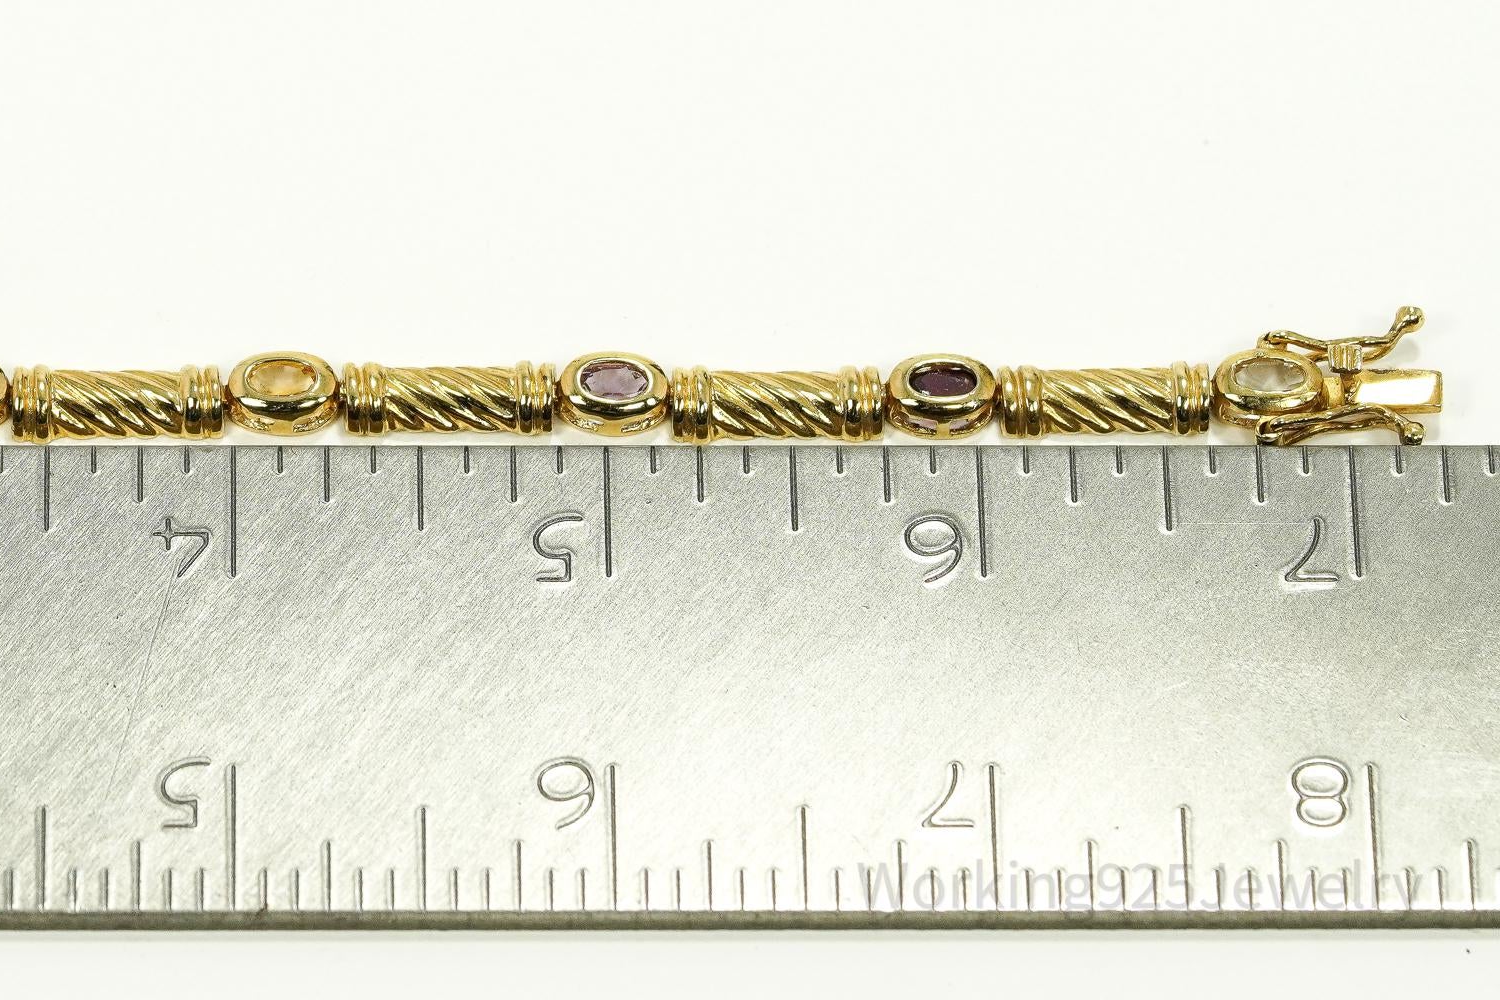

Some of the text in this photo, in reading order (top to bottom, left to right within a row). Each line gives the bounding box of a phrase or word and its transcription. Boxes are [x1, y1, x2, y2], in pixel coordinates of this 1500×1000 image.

[153, 516, 210, 579] 4
[532, 511, 584, 583] 5
[902, 513, 964, 583] 6
[1284, 517, 1340, 584] 7
[159, 757, 211, 829] 5
[536, 758, 596, 830] 6
[921, 762, 975, 829] 7
[1290, 759, 1349, 827] 8
